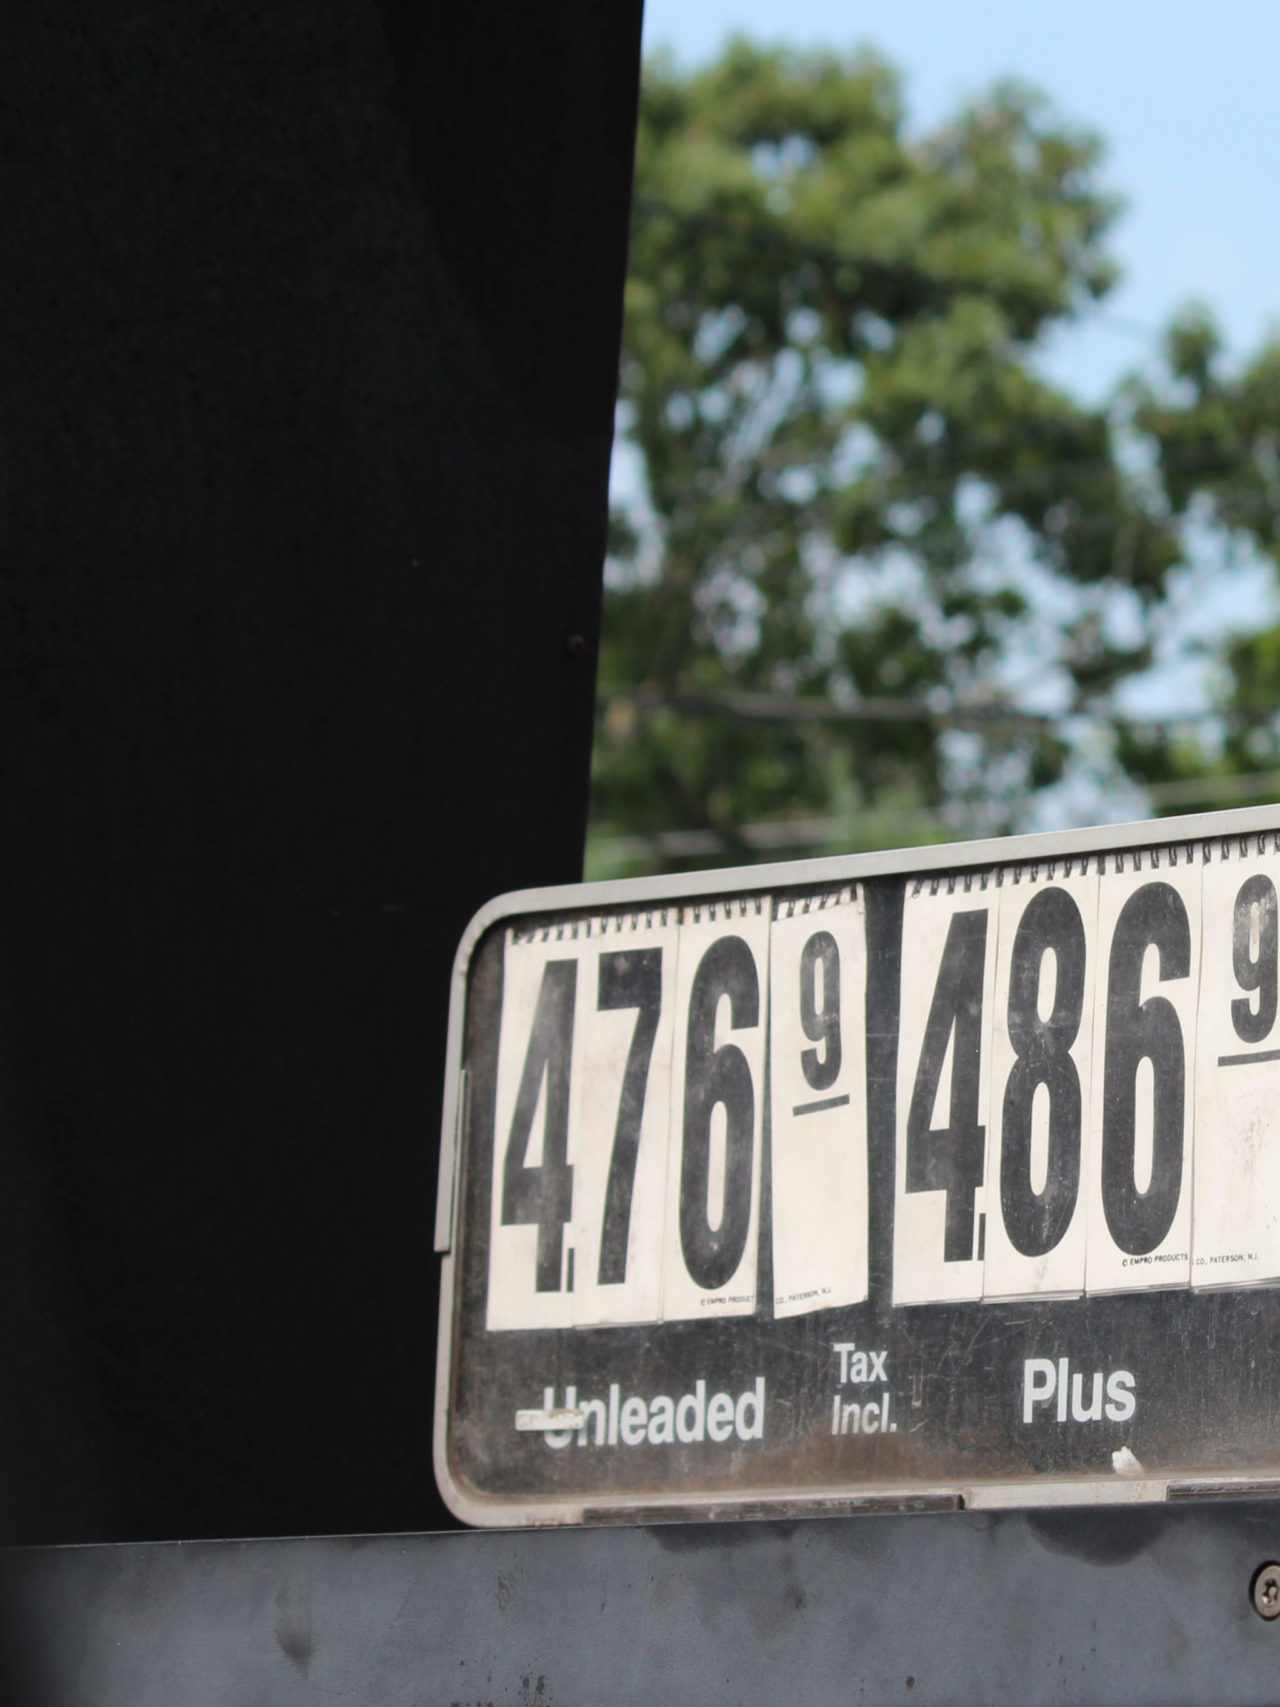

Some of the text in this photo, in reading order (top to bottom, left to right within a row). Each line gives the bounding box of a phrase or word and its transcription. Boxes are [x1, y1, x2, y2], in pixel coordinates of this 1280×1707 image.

[833, 1343, 887, 1384] Tax
[1022, 1357, 1137, 1424] Plus
[543, 1377, 765, 1449] Unleaded
[831, 1395, 898, 1435] Incl.
